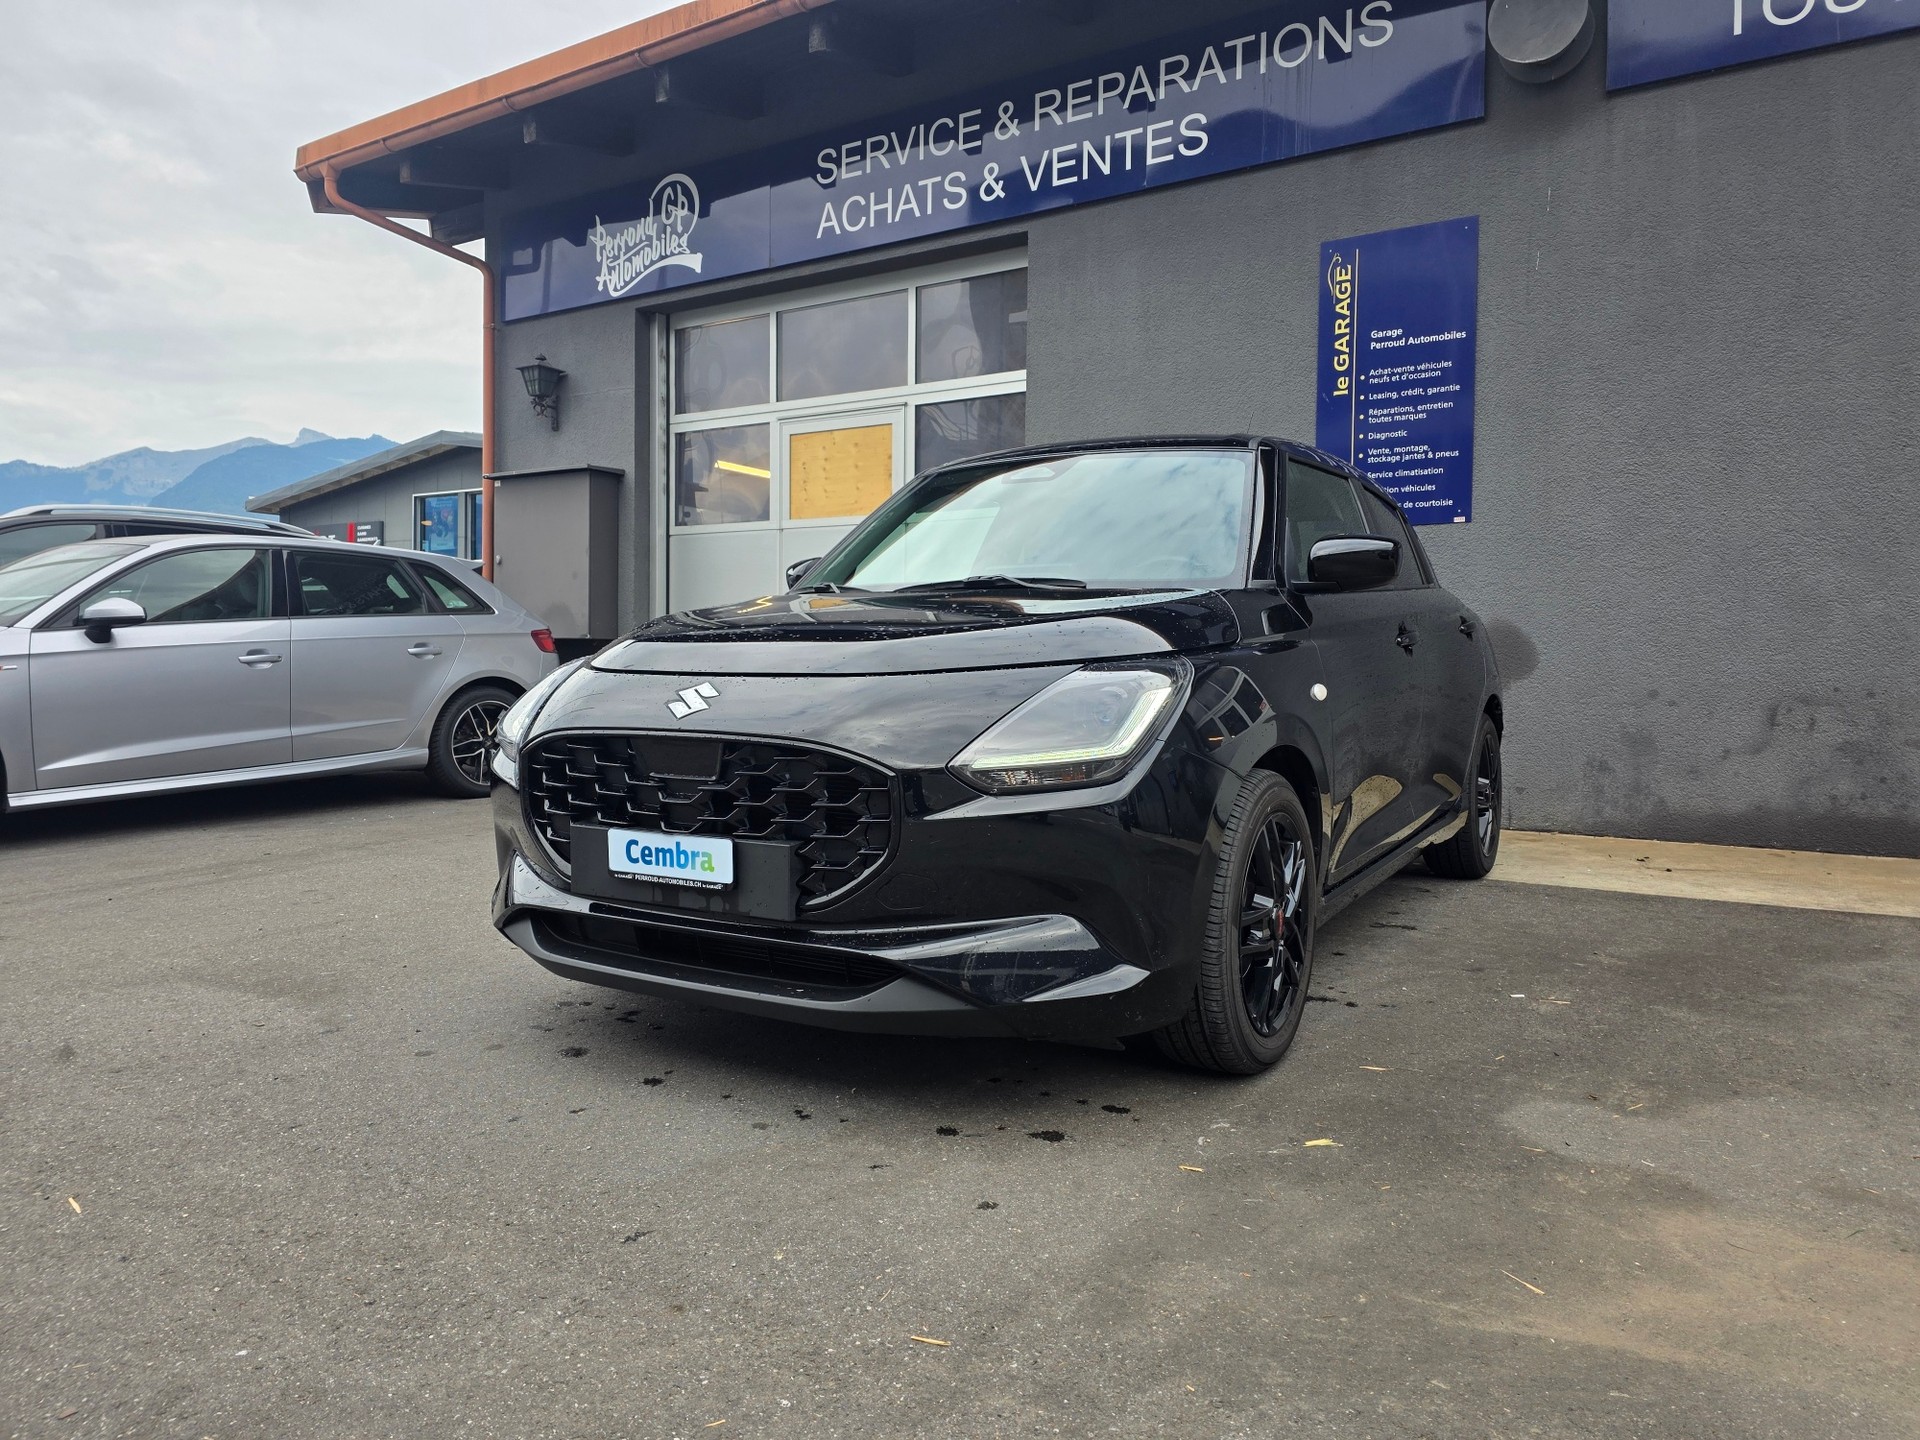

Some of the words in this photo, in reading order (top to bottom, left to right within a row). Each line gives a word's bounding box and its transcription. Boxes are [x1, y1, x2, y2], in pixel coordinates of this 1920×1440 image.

[816, 109, 982, 184] SERVICE
[994, 101, 1020, 140] &
[1034, 1, 1393, 131] REPARATIONS
[816, 171, 967, 239] ACHATS
[979, 162, 1006, 202] &
[1020, 112, 1209, 192] VENTES
[595, 222, 690, 292] Automobiles
[1333, 264, 1351, 371] GARAGE
[1370, 328, 1403, 339] Garage
[1370, 337, 1406, 350] Perroud
[1407, 330, 1467, 345] Automobiles
[1369, 364, 1415, 376] Achat-vente
[1416, 360, 1452, 371] véhicules
[1333, 376, 1349, 397] le
[1369, 375, 1390, 384] neufs
[1369, 390, 1399, 400] Leasing,
[1427, 383, 1460, 395] garantie
[1368, 405, 1415, 416] Réparations,
[1417, 401, 1454, 411] entretien
[1394, 412, 1427, 421] marques
[1368, 429, 1408, 440] Diagnostic
[1367, 448, 1391, 456] Vente,
[1393, 444, 1430, 453] montage,
[1367, 454, 1401, 464] stockage
[1401, 452, 1425, 462] jantes
[1435, 450, 1459, 459] pneus
[1367, 470, 1393, 479] Service
[1395, 467, 1444, 477] climatisation
[1400, 483, 1436, 493] véhicules
[1403, 500, 1414, 508] de
[1415, 498, 1453, 508] courtoisie
[625, 838, 715, 872] Cembra
